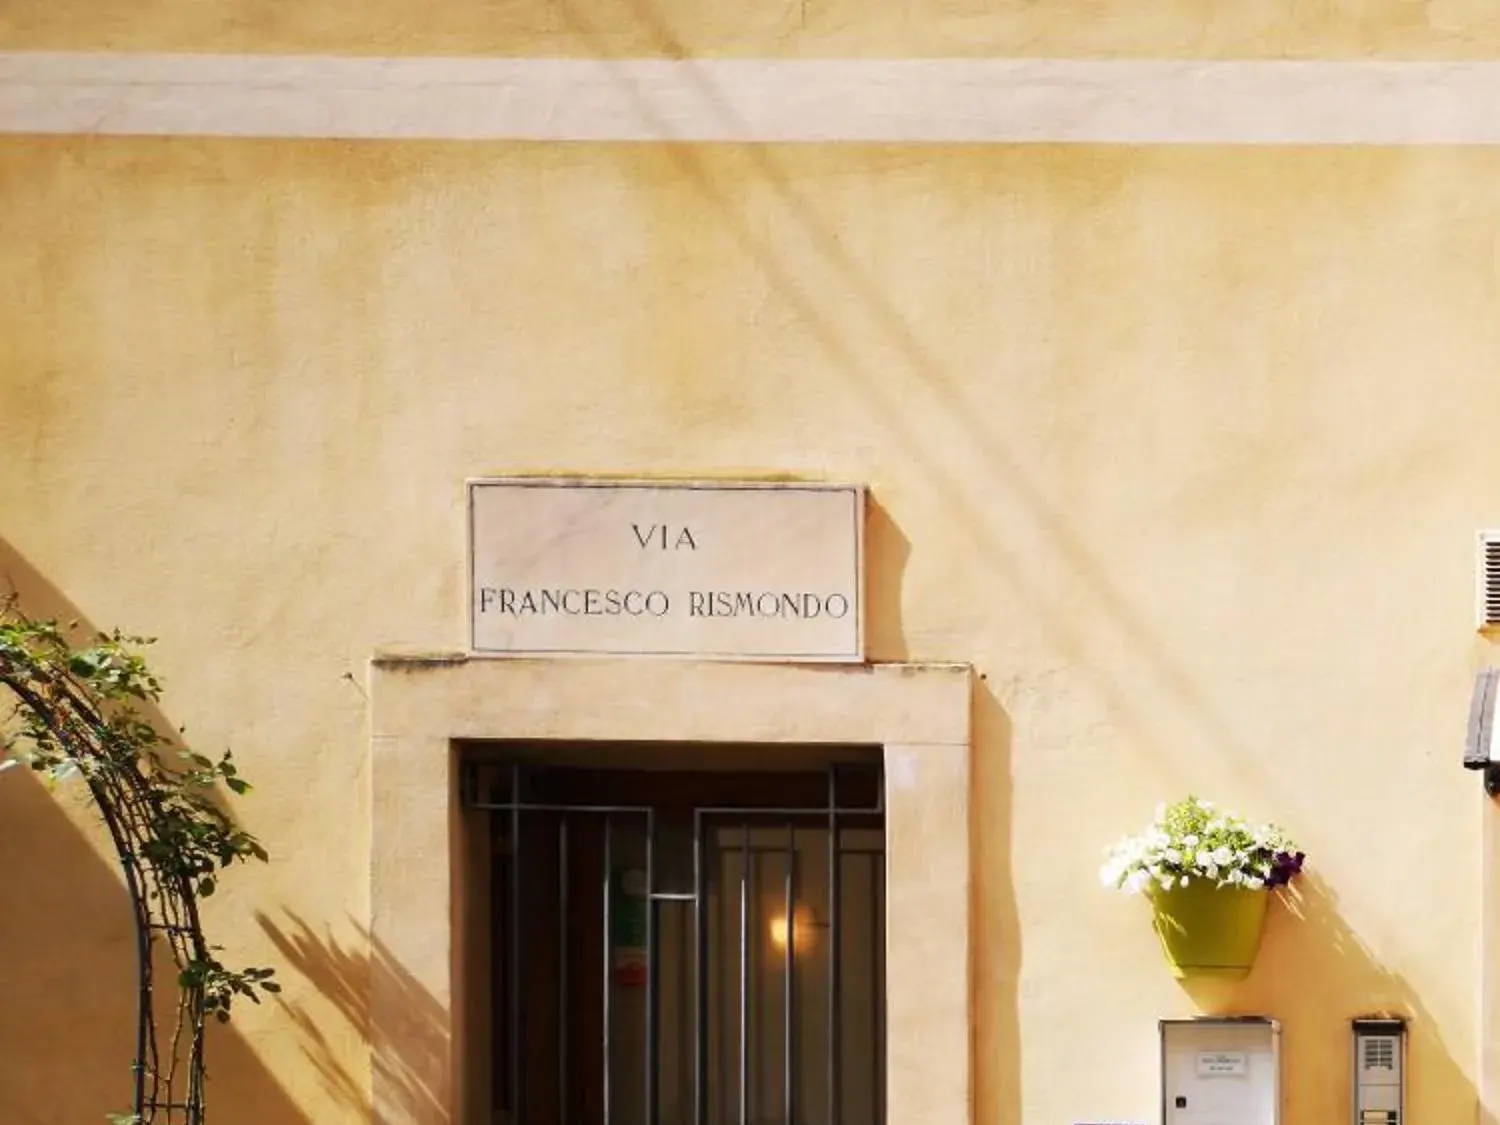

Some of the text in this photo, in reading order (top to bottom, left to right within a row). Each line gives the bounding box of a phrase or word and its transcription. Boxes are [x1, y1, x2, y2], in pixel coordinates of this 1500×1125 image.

[632, 524, 698, 550] VIA
[480, 588, 849, 618] FRANCESCO RISMONDO
